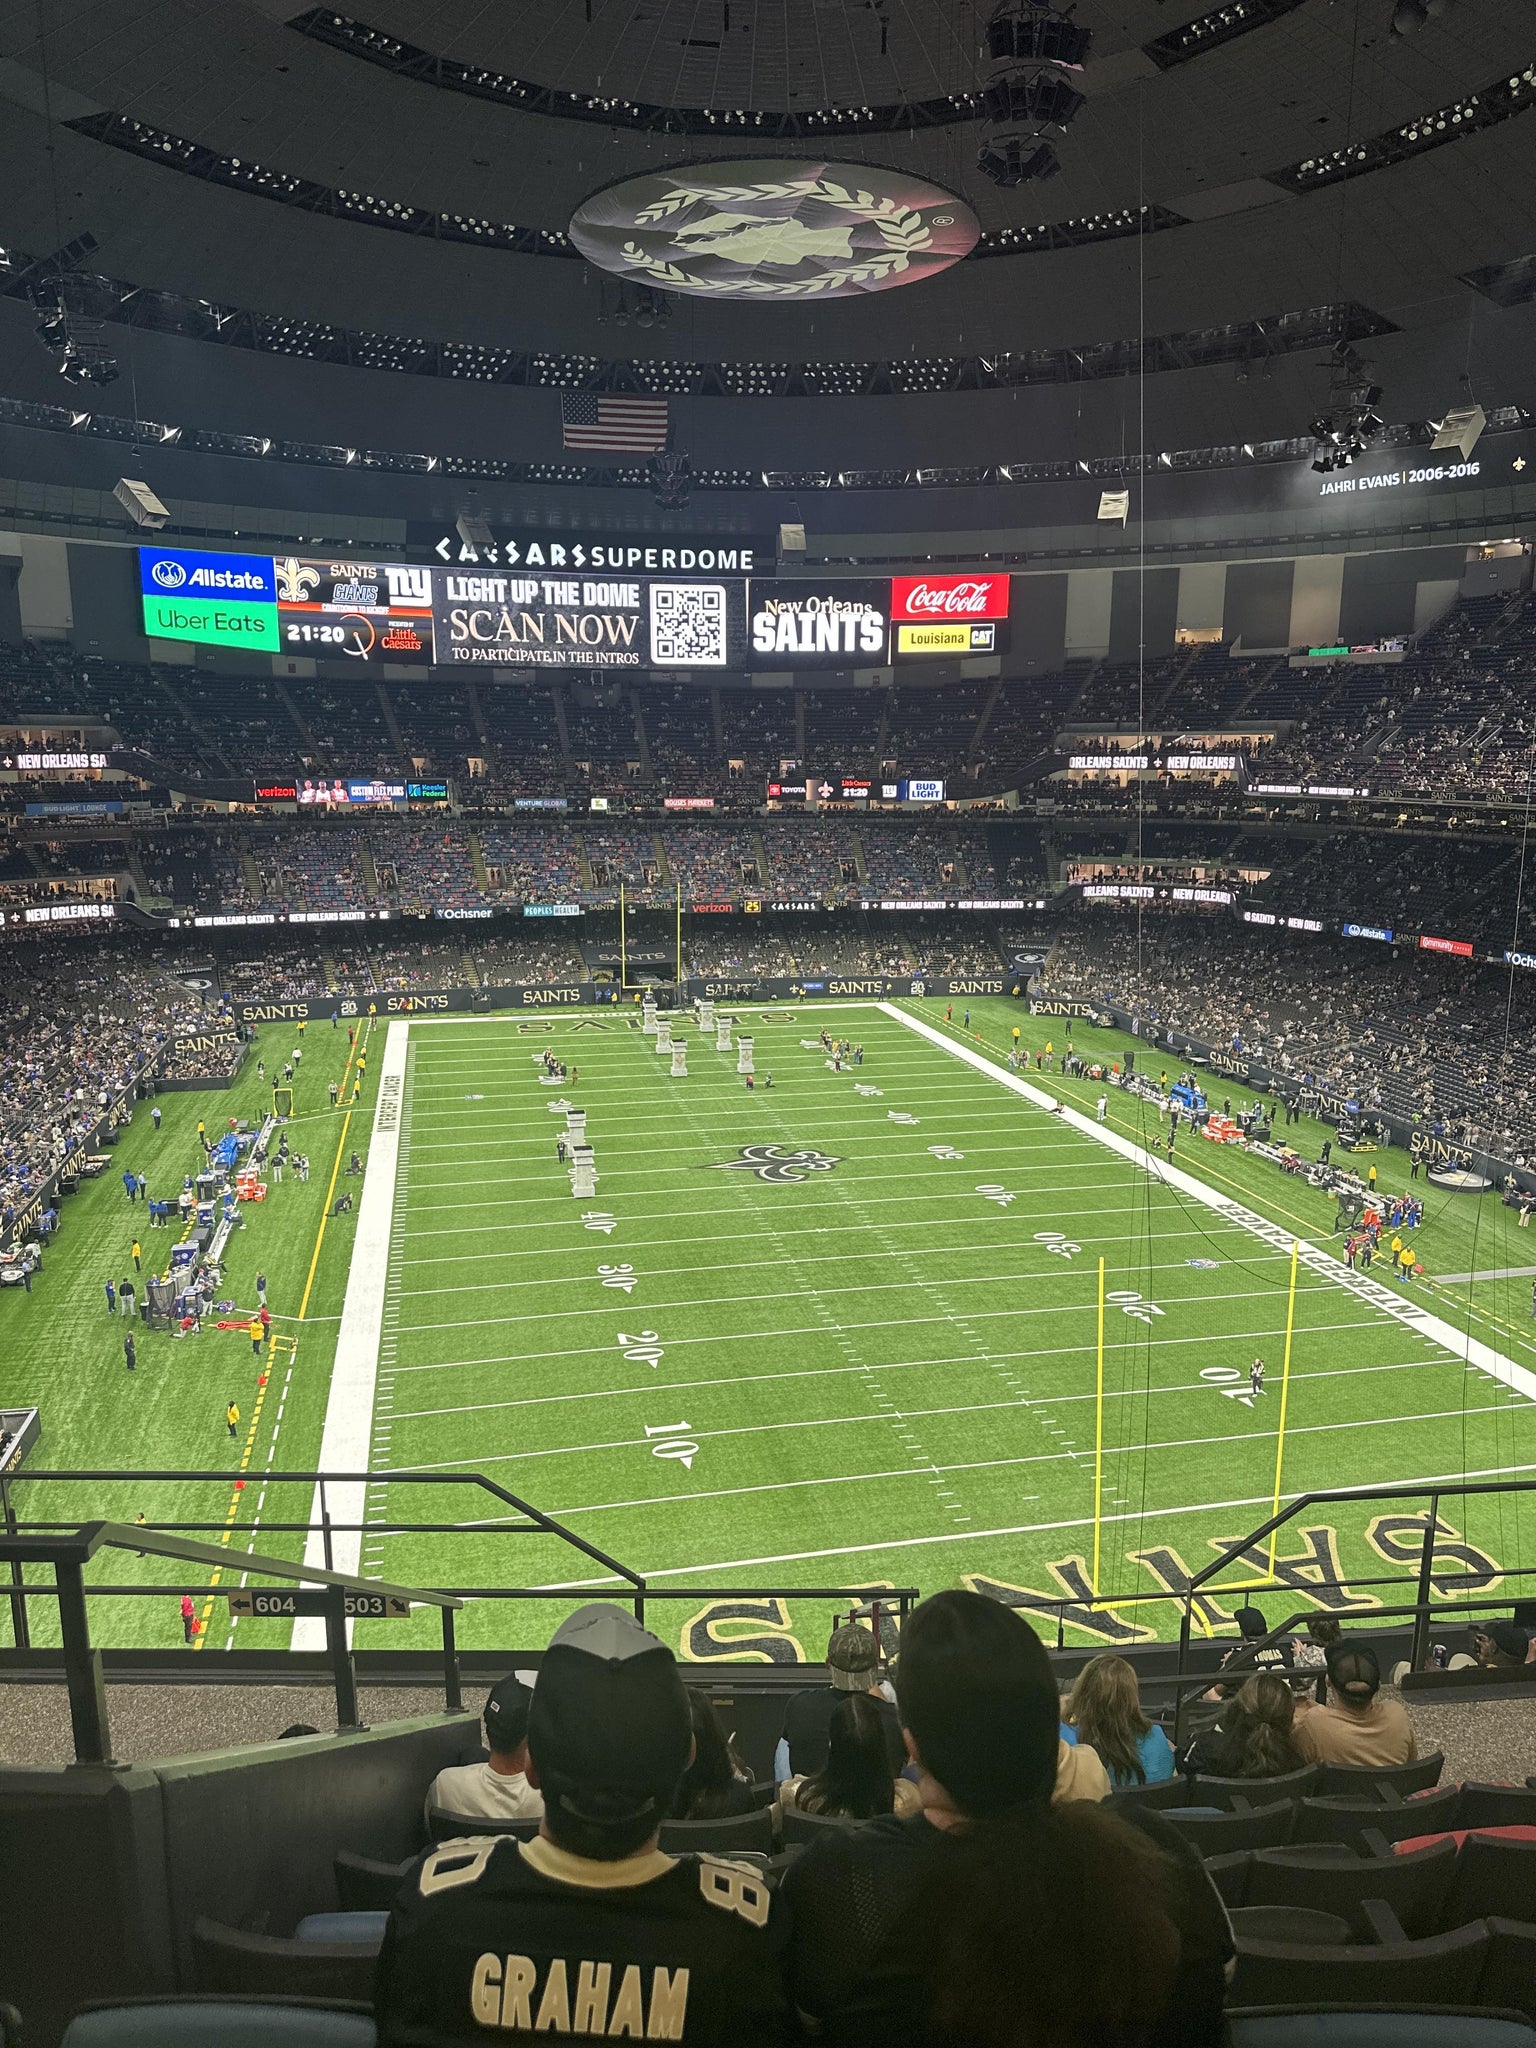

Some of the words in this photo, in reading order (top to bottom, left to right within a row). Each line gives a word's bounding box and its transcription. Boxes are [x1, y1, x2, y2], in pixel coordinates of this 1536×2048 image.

[1319, 479, 1356, 496] JAHRI
[1359, 472, 1400, 491] EVANS
[1408, 461, 1481, 484] 2006-2016
[590, 546, 754, 570] SUPERDOME
[330, 565, 377, 579] SAINTS
[333, 583, 378, 601] GIANTS
[446, 576, 507, 603] LIGHT
[510, 579, 539, 604] UP
[541, 580, 580, 606] THE
[582, 582, 641, 608] DOME
[905, 582, 993, 614] Coca-Cola
[764, 598, 803, 617] New
[806, 596, 873, 617] Orleans
[157, 609, 209, 631] Uber
[215, 612, 266, 634] Eats
[450, 608, 546, 644] SCAN
[554, 613, 640, 646] NOW
[286, 624, 346, 642] 21:20
[389, 628, 417, 640] Little
[753, 611, 884, 653] SAINTS
[910, 631, 964, 645] Louisiana
[970, 629, 992, 646] CAT
[381, 637, 422, 650] Caesars
[452, 647, 470, 659] TO
[471, 648, 551, 663] PARTICIPATE
[552, 651, 567, 663] IN
[569, 651, 594, 664] THE
[595, 652, 640, 665] INTROS
[18, 754, 41, 769] NEW
[42, 753, 89, 769] ORLEANS
[1113, 756, 1149, 769] SAINTS
[1167, 756, 1189, 769] NEW
[1190, 756, 1229, 769] ORLEANS
[257, 787, 296, 797] verizon
[374, 786, 387, 796] FLEX
[781, 786, 806, 794] TOYOTA
[842, 788, 869, 797] 21:20
[911, 790, 941, 799] LIGHT
[915, 783, 936, 791] BUD
[1378, 788, 1403, 798] SAINTS
[1431, 791, 1457, 801] SAINTS
[1485, 793, 1513, 803] SAINTS
[1120, 885, 1155, 898] SAINTS
[1173, 888, 1194, 901] NEW
[403, 907, 431, 916] SAINTS
[525, 906, 553, 916] PEOPLES
[553, 905, 579, 915] HEALTH
[588, 903, 615, 911] SAINTS
[692, 902, 733, 913] verizon
[747, 902, 760, 911] 25
[771, 902, 816, 911] CAESARS
[823, 900, 848, 908] SAINTS
[881, 902, 896, 910] NEW
[896, 901, 923, 910] ORLEANS
[923, 901, 947, 910] SAINTS
[958, 901, 973, 909] NEW
[973, 901, 1001, 909] ORLEANS
[1001, 901, 1024, 909] SAINTS
[26, 908, 51, 922] NEW
[51, 905, 101, 919] ORLEANS
[194, 916, 213, 927] NEW
[213, 915, 247, 926] ORLEANS
[247, 914, 275, 925] SAINTS
[289, 913, 307, 923] NEW
[307, 912, 339, 922] ORLEANS
[339, 911, 366, 921] SAINTS
[444, 908, 493, 919] Ochsner
[1252, 912, 1276, 926] SAINTS
[1287, 918, 1302, 932] NEW
[1396, 932, 1420, 945] SAINTS
[829, 980, 883, 994] SAINTS
[949, 980, 1003, 994] SAINTS
[387, 994, 449, 1011] SAINTS
[522, 988, 581, 1004] SAINTS
[243, 1003, 310, 1022] SAINTS
[1034, 1000, 1091, 1017] SAINTS
[174, 1032, 239, 1052] SAINTS
[1209, 1051, 1249, 1076] SAINTS
[382, 1074, 401, 1097] CANCER
[377, 1098, 399, 1132] INTERCEPT
[926, 1145, 965, 1160] 50
[1410, 1131, 1474, 1166] SAINTS
[974, 1184, 1017, 1201] 40
[580, 1211, 617, 1231] 40
[1215, 1202, 1296, 1246] CANCER
[1032, 1231, 1082, 1254] 30
[597, 1263, 638, 1288] 30
[1295, 1247, 1428, 1322] INTERCEPT
[1105, 1290, 1166, 1318] 20
[616, 1329, 665, 1361] 20
[1199, 1366, 1268, 1400] 10
[644, 1419, 700, 1460] 10
[255, 1596, 297, 1614] 604
[343, 1597, 383, 1614] 503
[1253, 1648, 1284, 1663] THOMAS
[470, 1951, 690, 2041] GRAHAM
